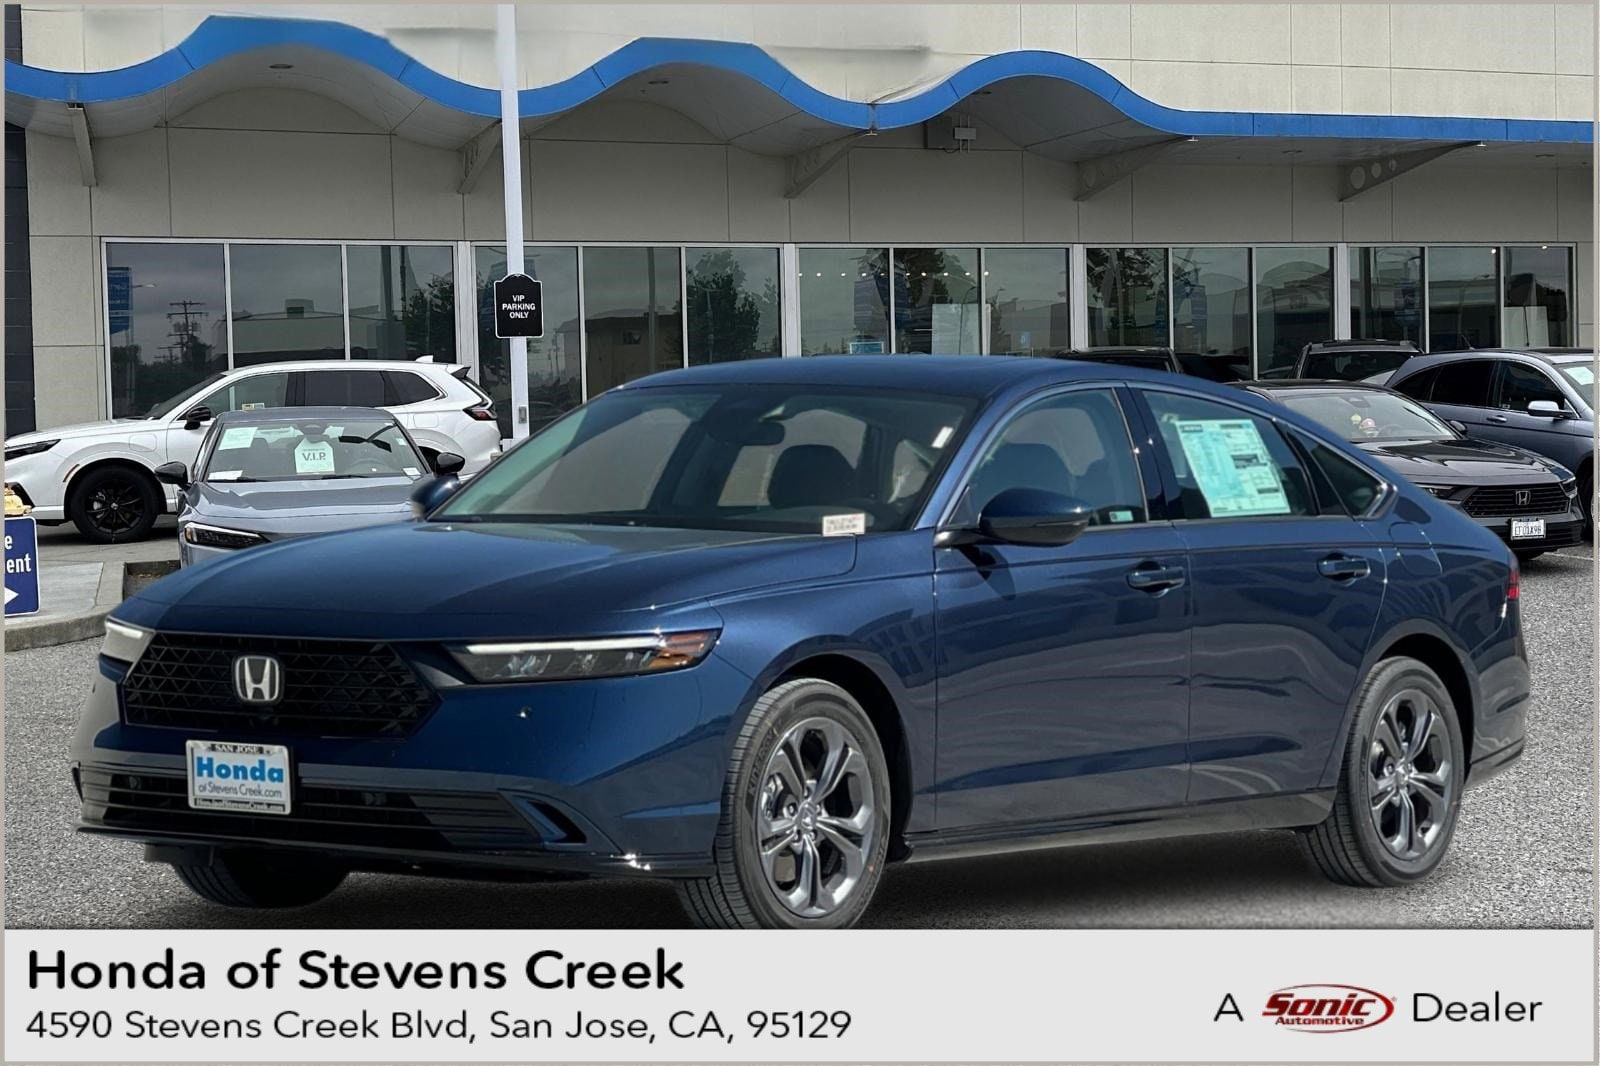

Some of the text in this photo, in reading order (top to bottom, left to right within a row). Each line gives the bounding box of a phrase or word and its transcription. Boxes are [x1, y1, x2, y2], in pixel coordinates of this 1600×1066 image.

[502, 303, 536, 311] PARKING
[509, 311, 529, 319] ONLY
[214, 744, 234, 752] SAN
[196, 756, 284, 784] Honda
